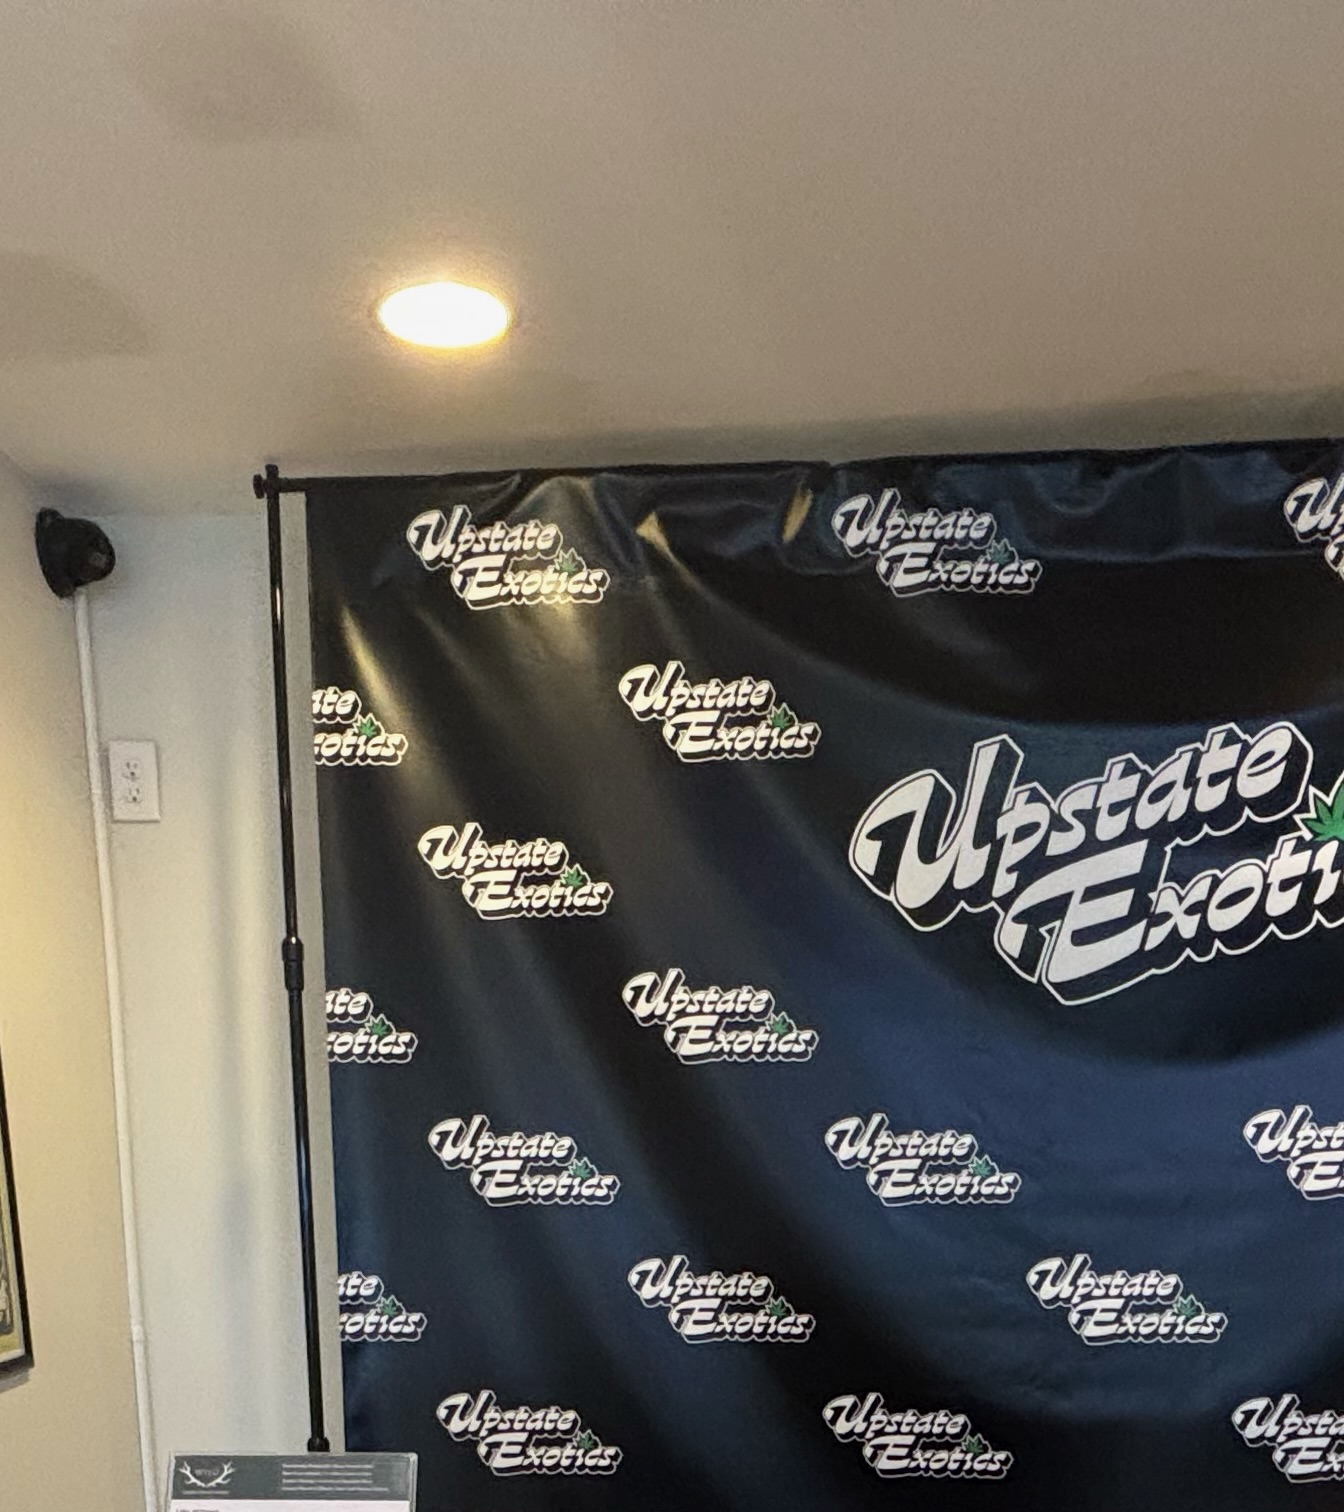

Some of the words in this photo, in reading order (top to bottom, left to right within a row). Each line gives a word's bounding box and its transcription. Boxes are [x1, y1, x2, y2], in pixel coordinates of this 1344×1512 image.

[409, 506, 561, 567] Upstate
[835, 489, 992, 552] Upstate
[451, 555, 607, 607] Exotics
[879, 539, 1040, 593] Exotics
[621, 662, 773, 721] Upstate
[663, 709, 819, 759] Exotics
[851, 722, 1306, 922] Upstate
[420, 824, 566, 880] Upstate
[461, 869, 611, 916] Exotics
[623, 969, 771, 1024] Upstate
[664, 1013, 816, 1060] Exotics
[430, 1116, 574, 1169] Upstate
[826, 1114, 974, 1168] Upstate
[470, 1159, 618, 1204] Exotics
[868, 1158, 1020, 1204] Exotics
[630, 1256, 771, 1307] Upstate
[1028, 1254, 1180, 1307] Upstate
[669, 1297, 814, 1340] Exotics
[1070, 1297, 1226, 1342] Exotics
[438, 1391, 578, 1441] Upstate
[824, 1394, 968, 1444] Upstate
[477, 1431, 621, 1473] Exotics
[864, 1434, 1012, 1476] Exotics
